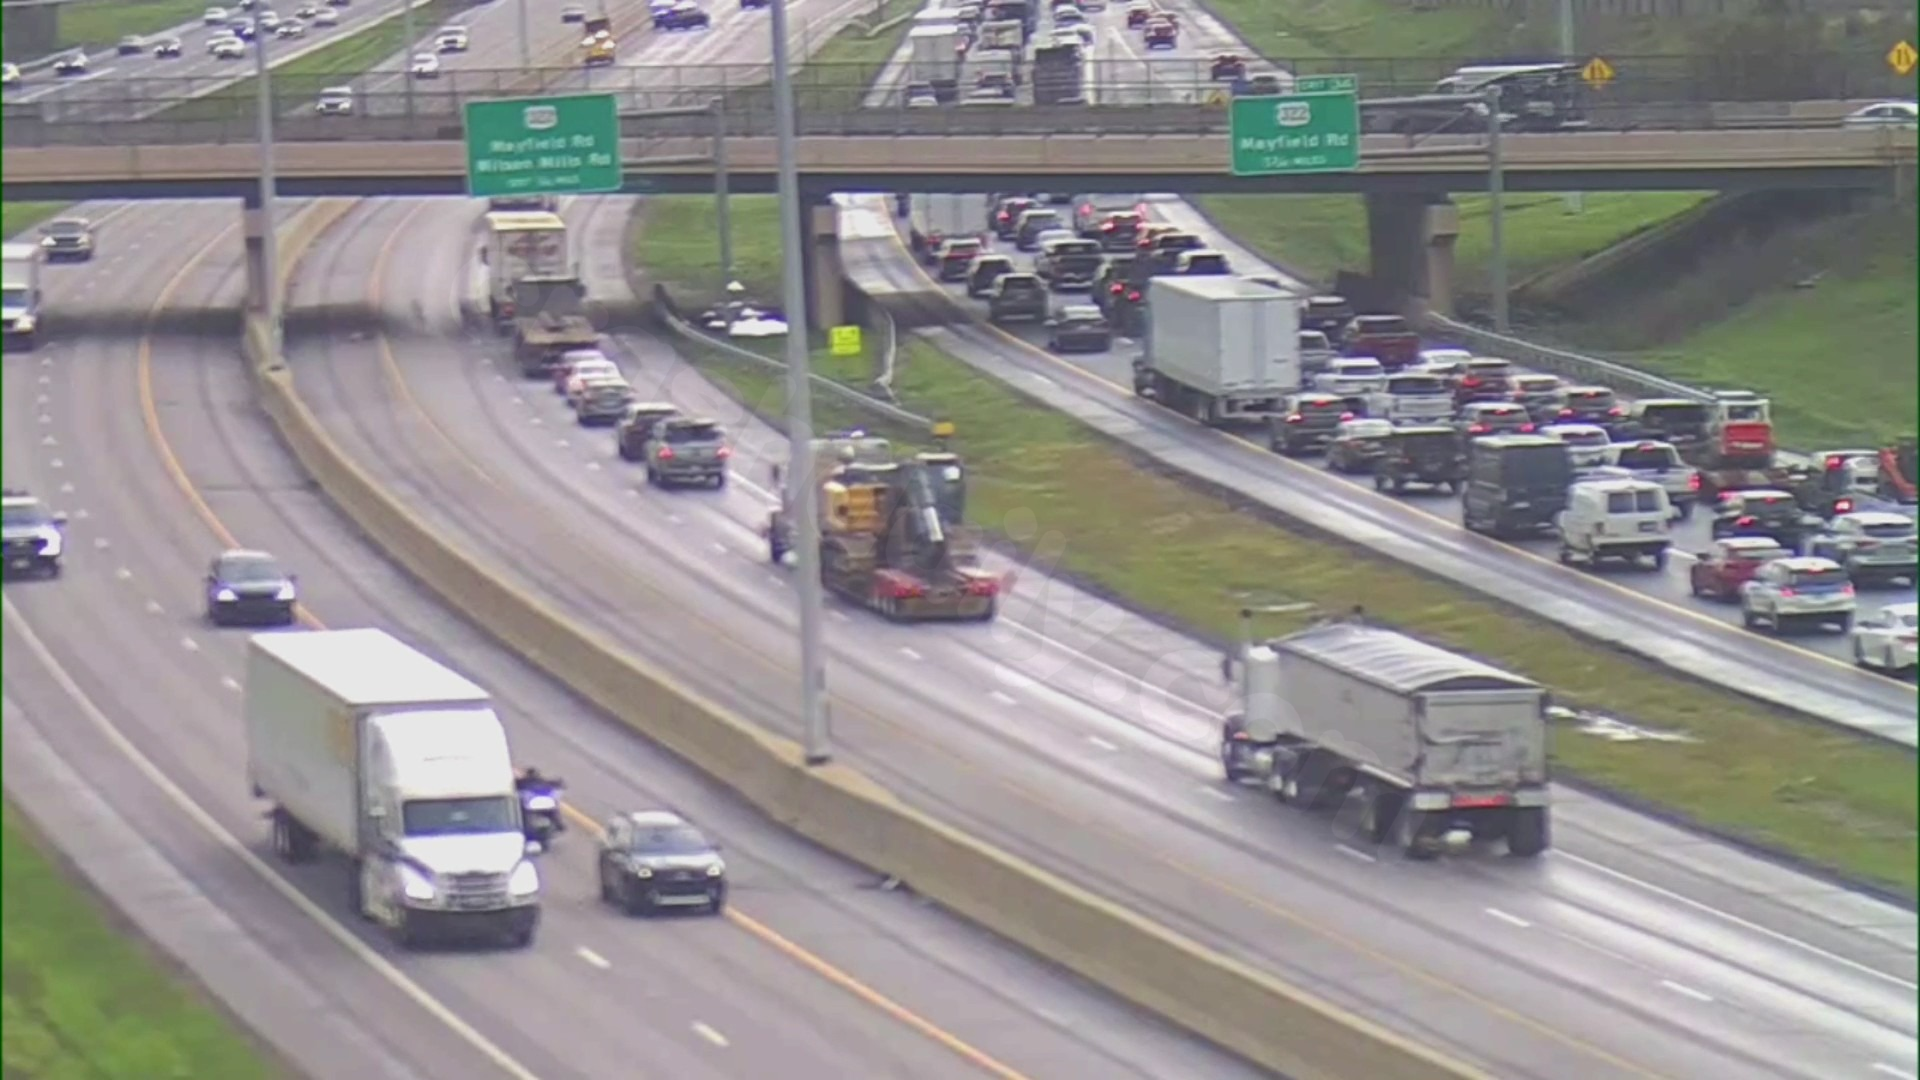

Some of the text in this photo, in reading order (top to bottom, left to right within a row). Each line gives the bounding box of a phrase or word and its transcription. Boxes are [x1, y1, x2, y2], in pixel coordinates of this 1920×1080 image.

[489, 134, 596, 153] Mayfield Rd
[1241, 133, 1349, 152] Mayfield Rd
[588, 152, 612, 166] Rd
